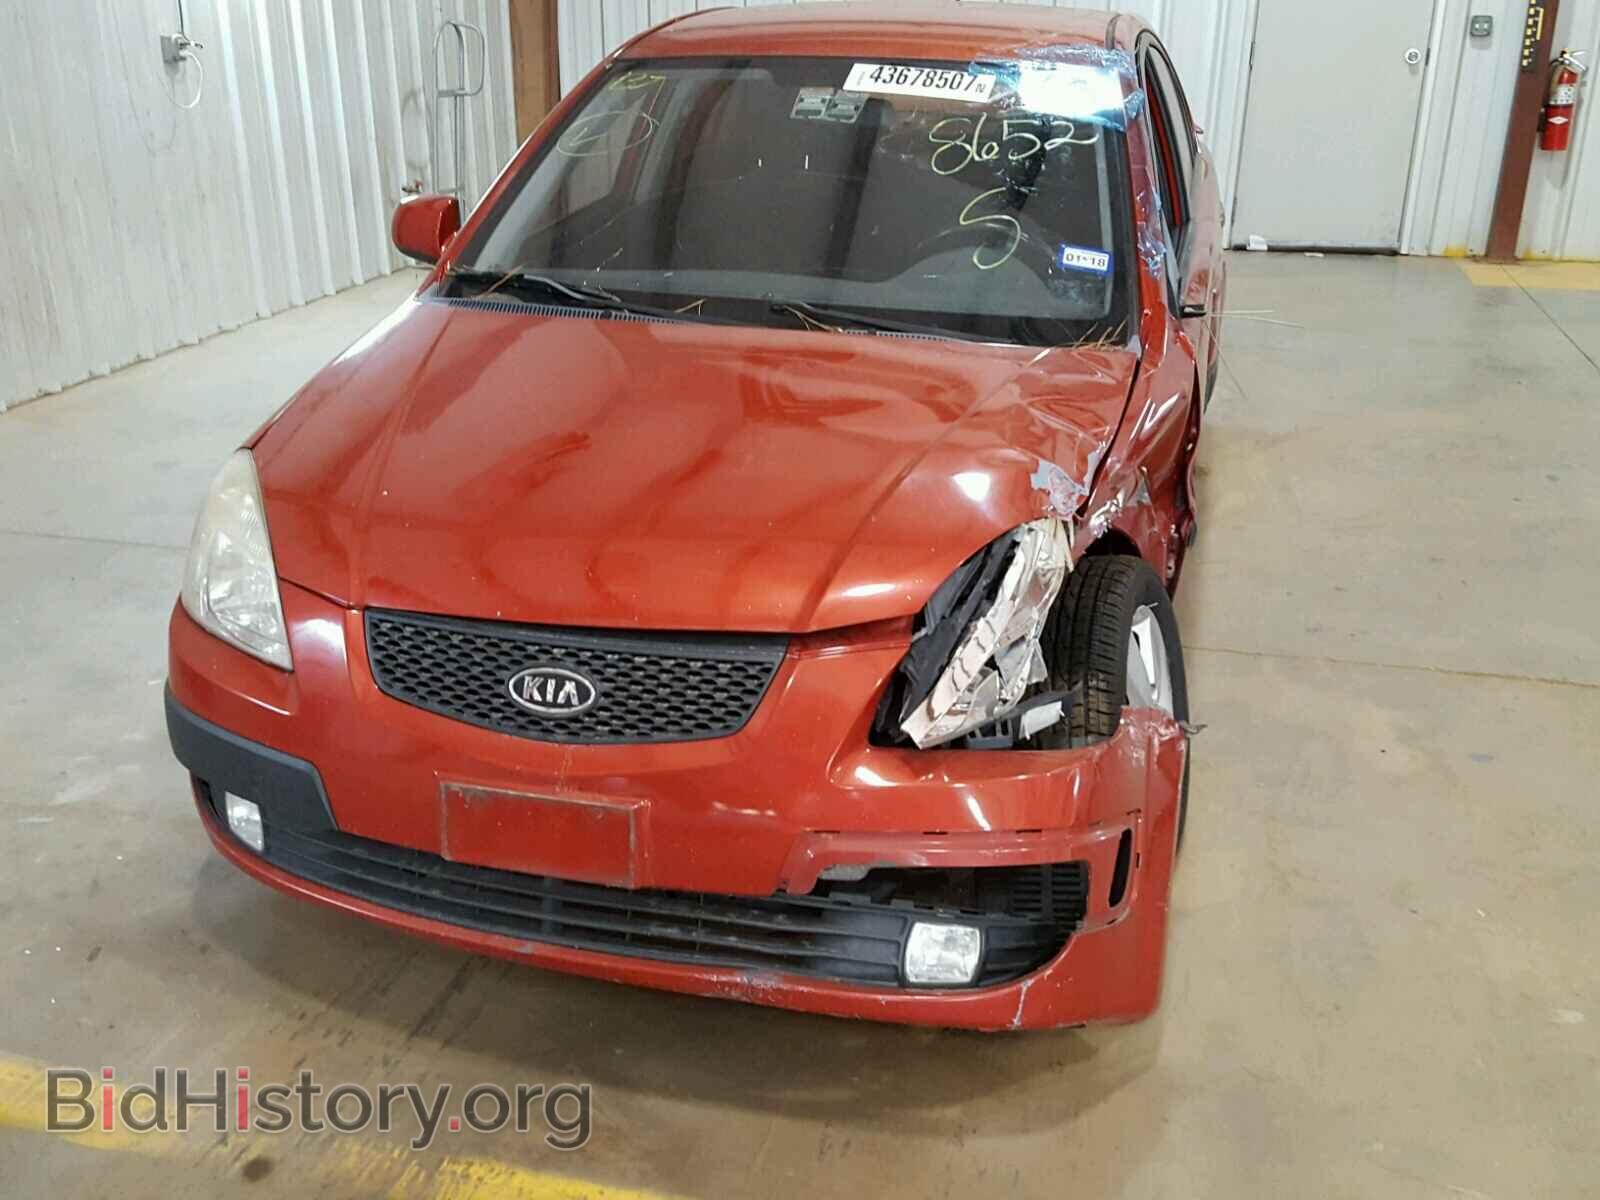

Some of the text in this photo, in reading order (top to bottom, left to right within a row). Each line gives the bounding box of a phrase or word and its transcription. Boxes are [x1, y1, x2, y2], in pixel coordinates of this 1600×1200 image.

[868, 65, 977, 92] 43678507
[928, 112, 1100, 175] 8652
[522, 675, 580, 706] KIA
